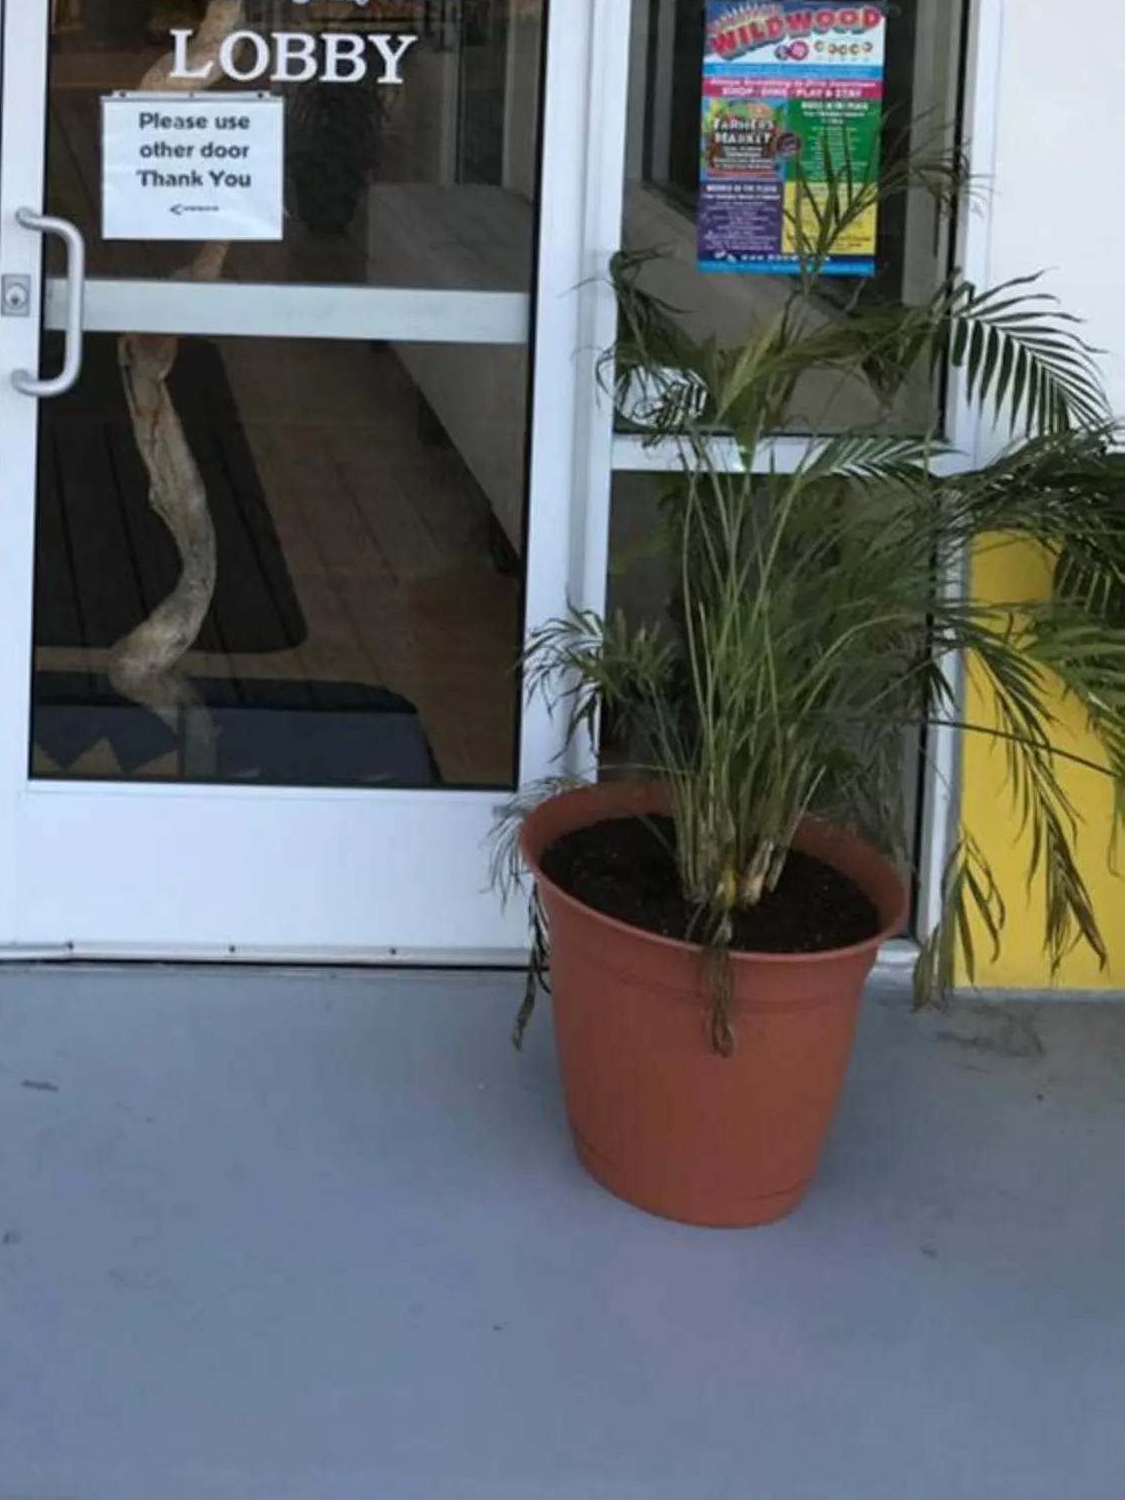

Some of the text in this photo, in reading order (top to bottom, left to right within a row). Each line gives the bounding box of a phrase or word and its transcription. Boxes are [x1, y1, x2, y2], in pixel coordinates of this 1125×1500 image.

[709, 4, 883, 55] WILDWOOD
[169, 29, 418, 84] LOBBY
[139, 112, 250, 130] Please use
[139, 142, 250, 159] other door
[137, 170, 252, 188] Thank You
